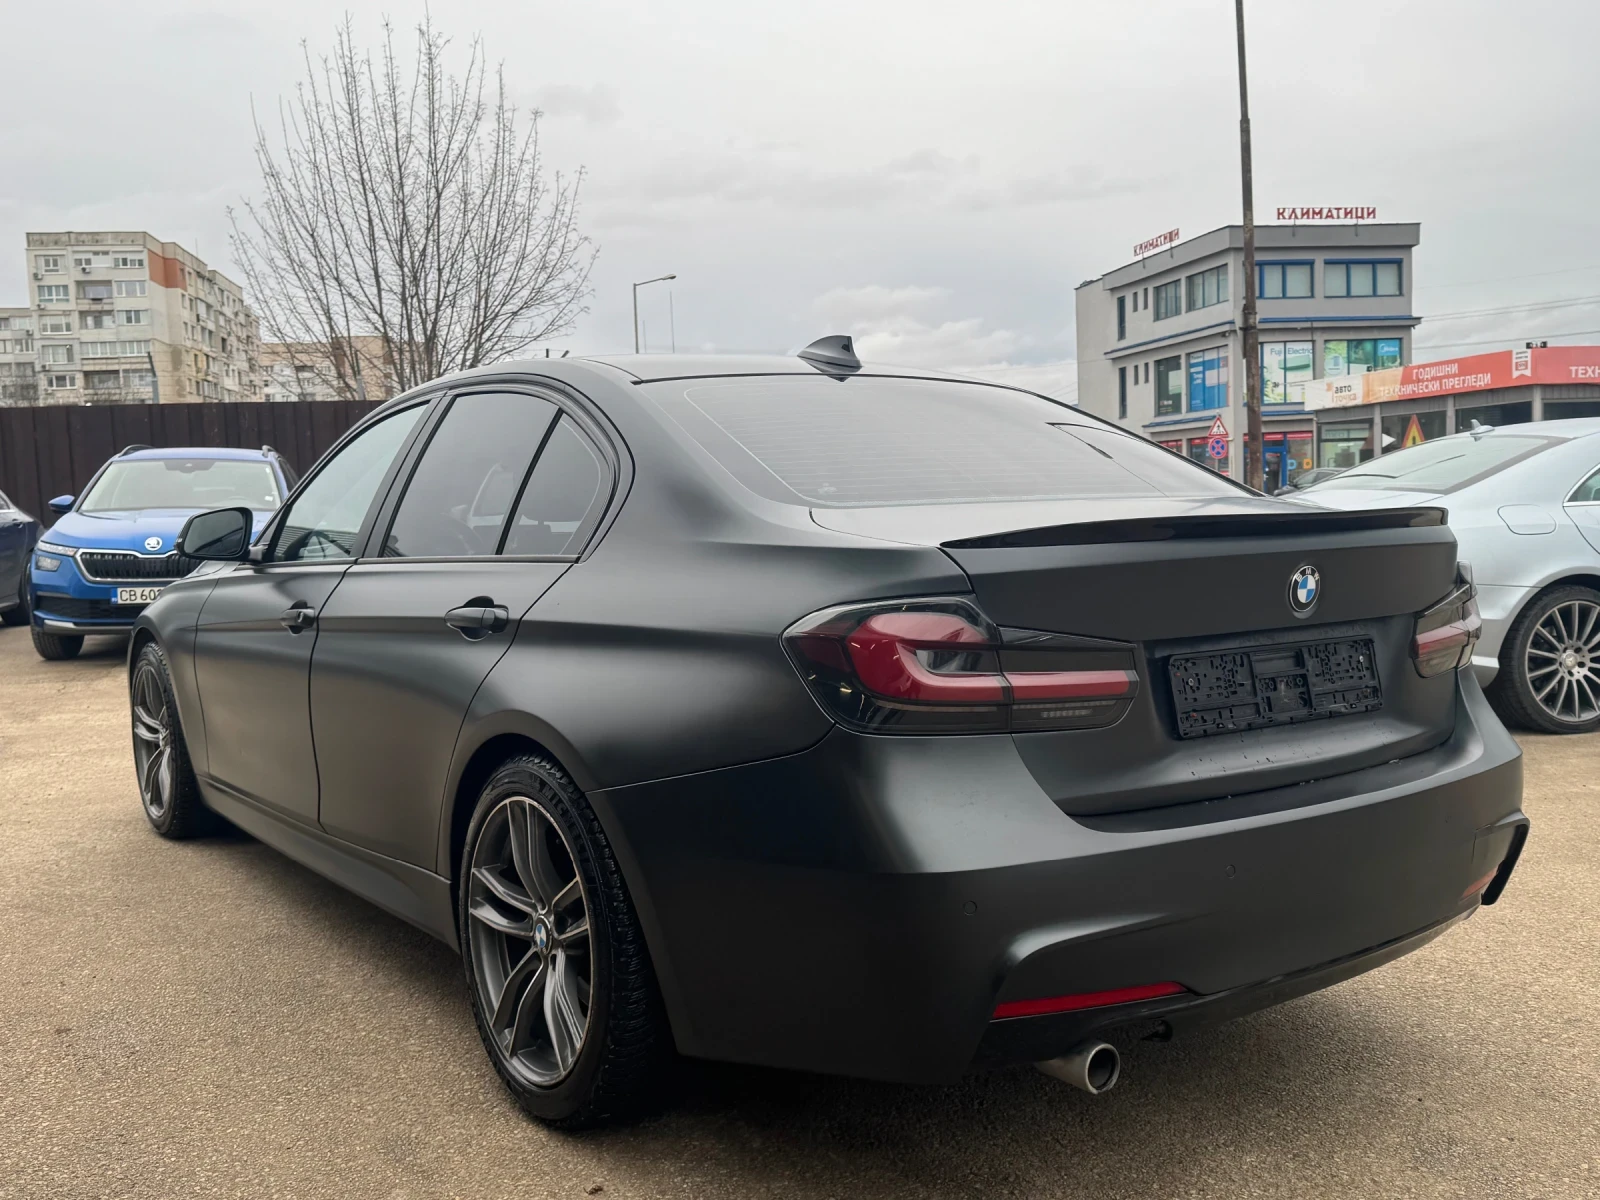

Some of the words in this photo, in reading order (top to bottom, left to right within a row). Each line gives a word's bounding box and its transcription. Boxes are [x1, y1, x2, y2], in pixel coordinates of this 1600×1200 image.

[1276, 207, 1376, 220] КЛИМАТИЦИ
[1133, 228, 1179, 256] КЛИМАТИЦИ
[1270, 348, 1282, 356] Fuji
[1288, 347, 1312, 355] Electric
[1413, 363, 1458, 380] ГОДИШНИ
[1442, 373, 1491, 390] ПРЕГЛЕДИ
[1295, 567, 1320, 582] BMW
[120, 589, 137, 602] CB
